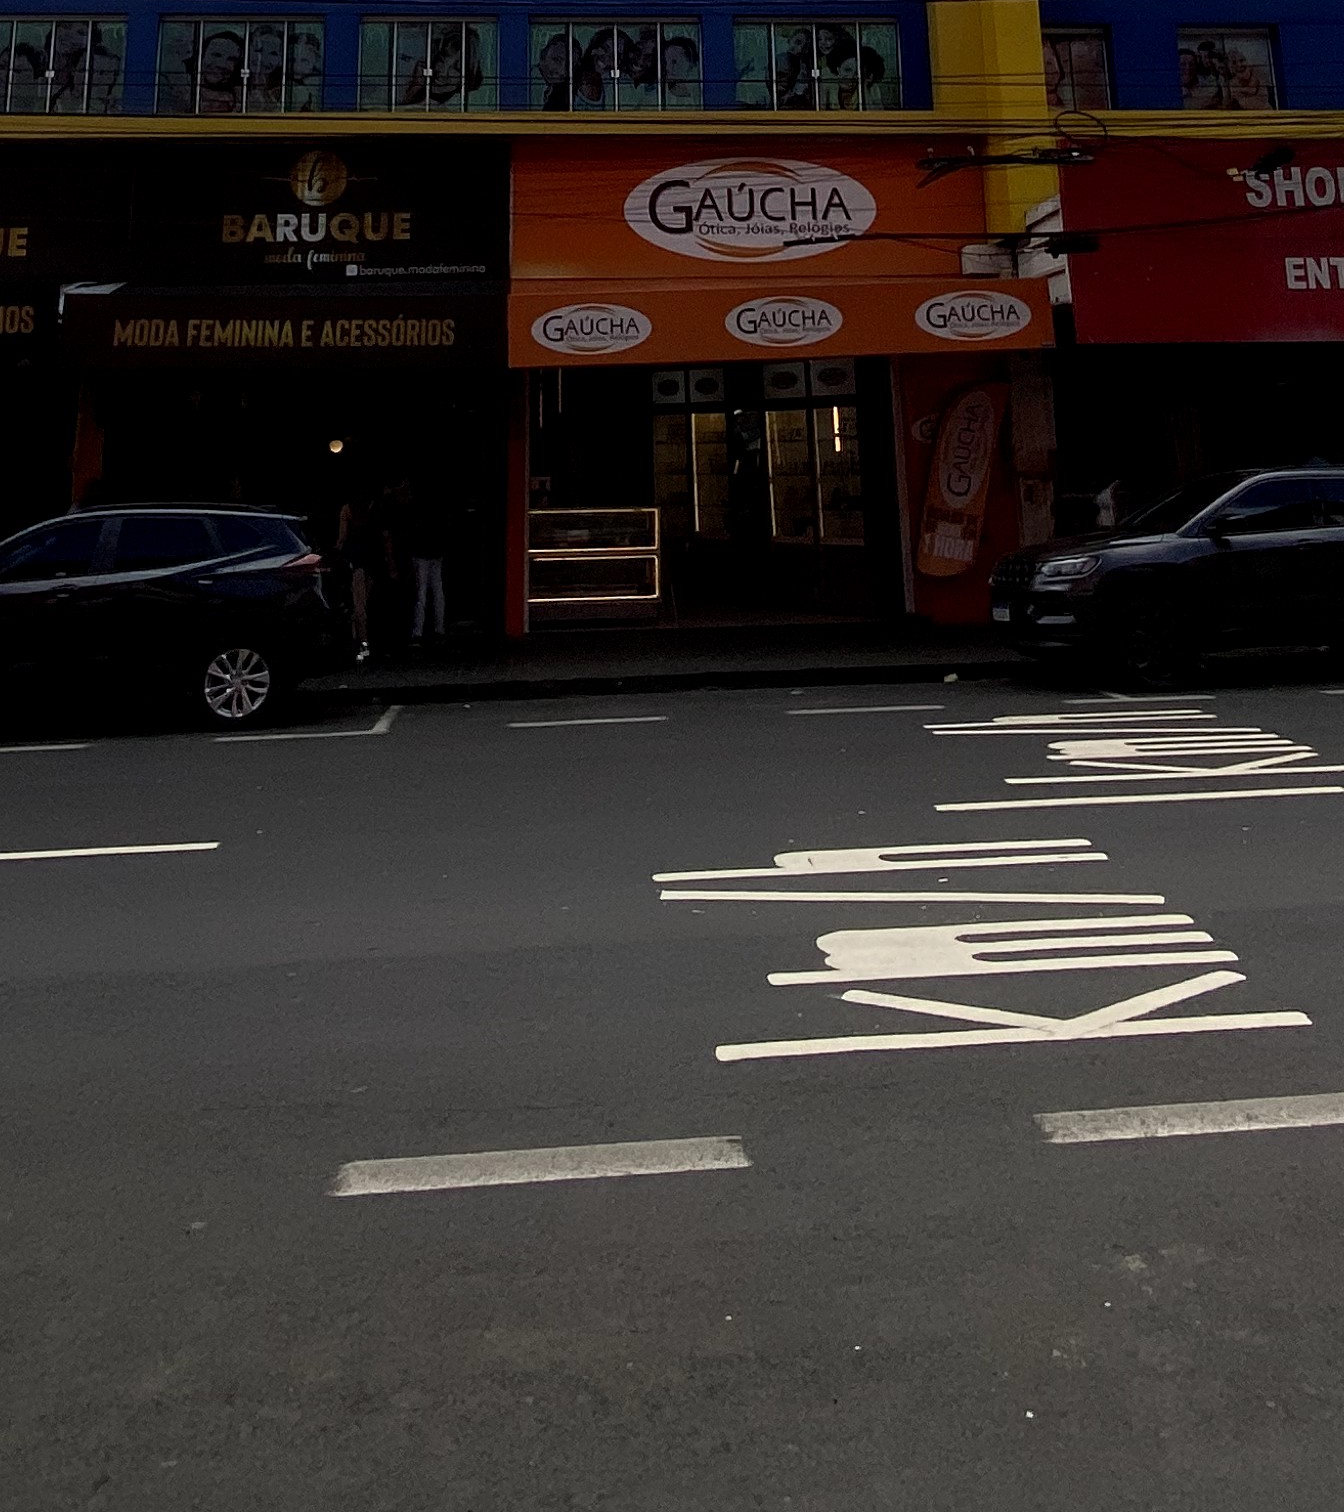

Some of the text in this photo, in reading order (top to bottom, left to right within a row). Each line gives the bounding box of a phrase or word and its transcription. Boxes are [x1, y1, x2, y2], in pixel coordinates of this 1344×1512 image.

[649, 179, 851, 234] GAÚCHA
[221, 212, 412, 243] BARUQUE
[543, 315, 641, 342] GAÚCHA
[736, 307, 832, 334] GAÚCHA
[926, 302, 1021, 328] GAÚCHA
[113, 313, 456, 348] MODA FEMININA E ACESSÓRIOS
